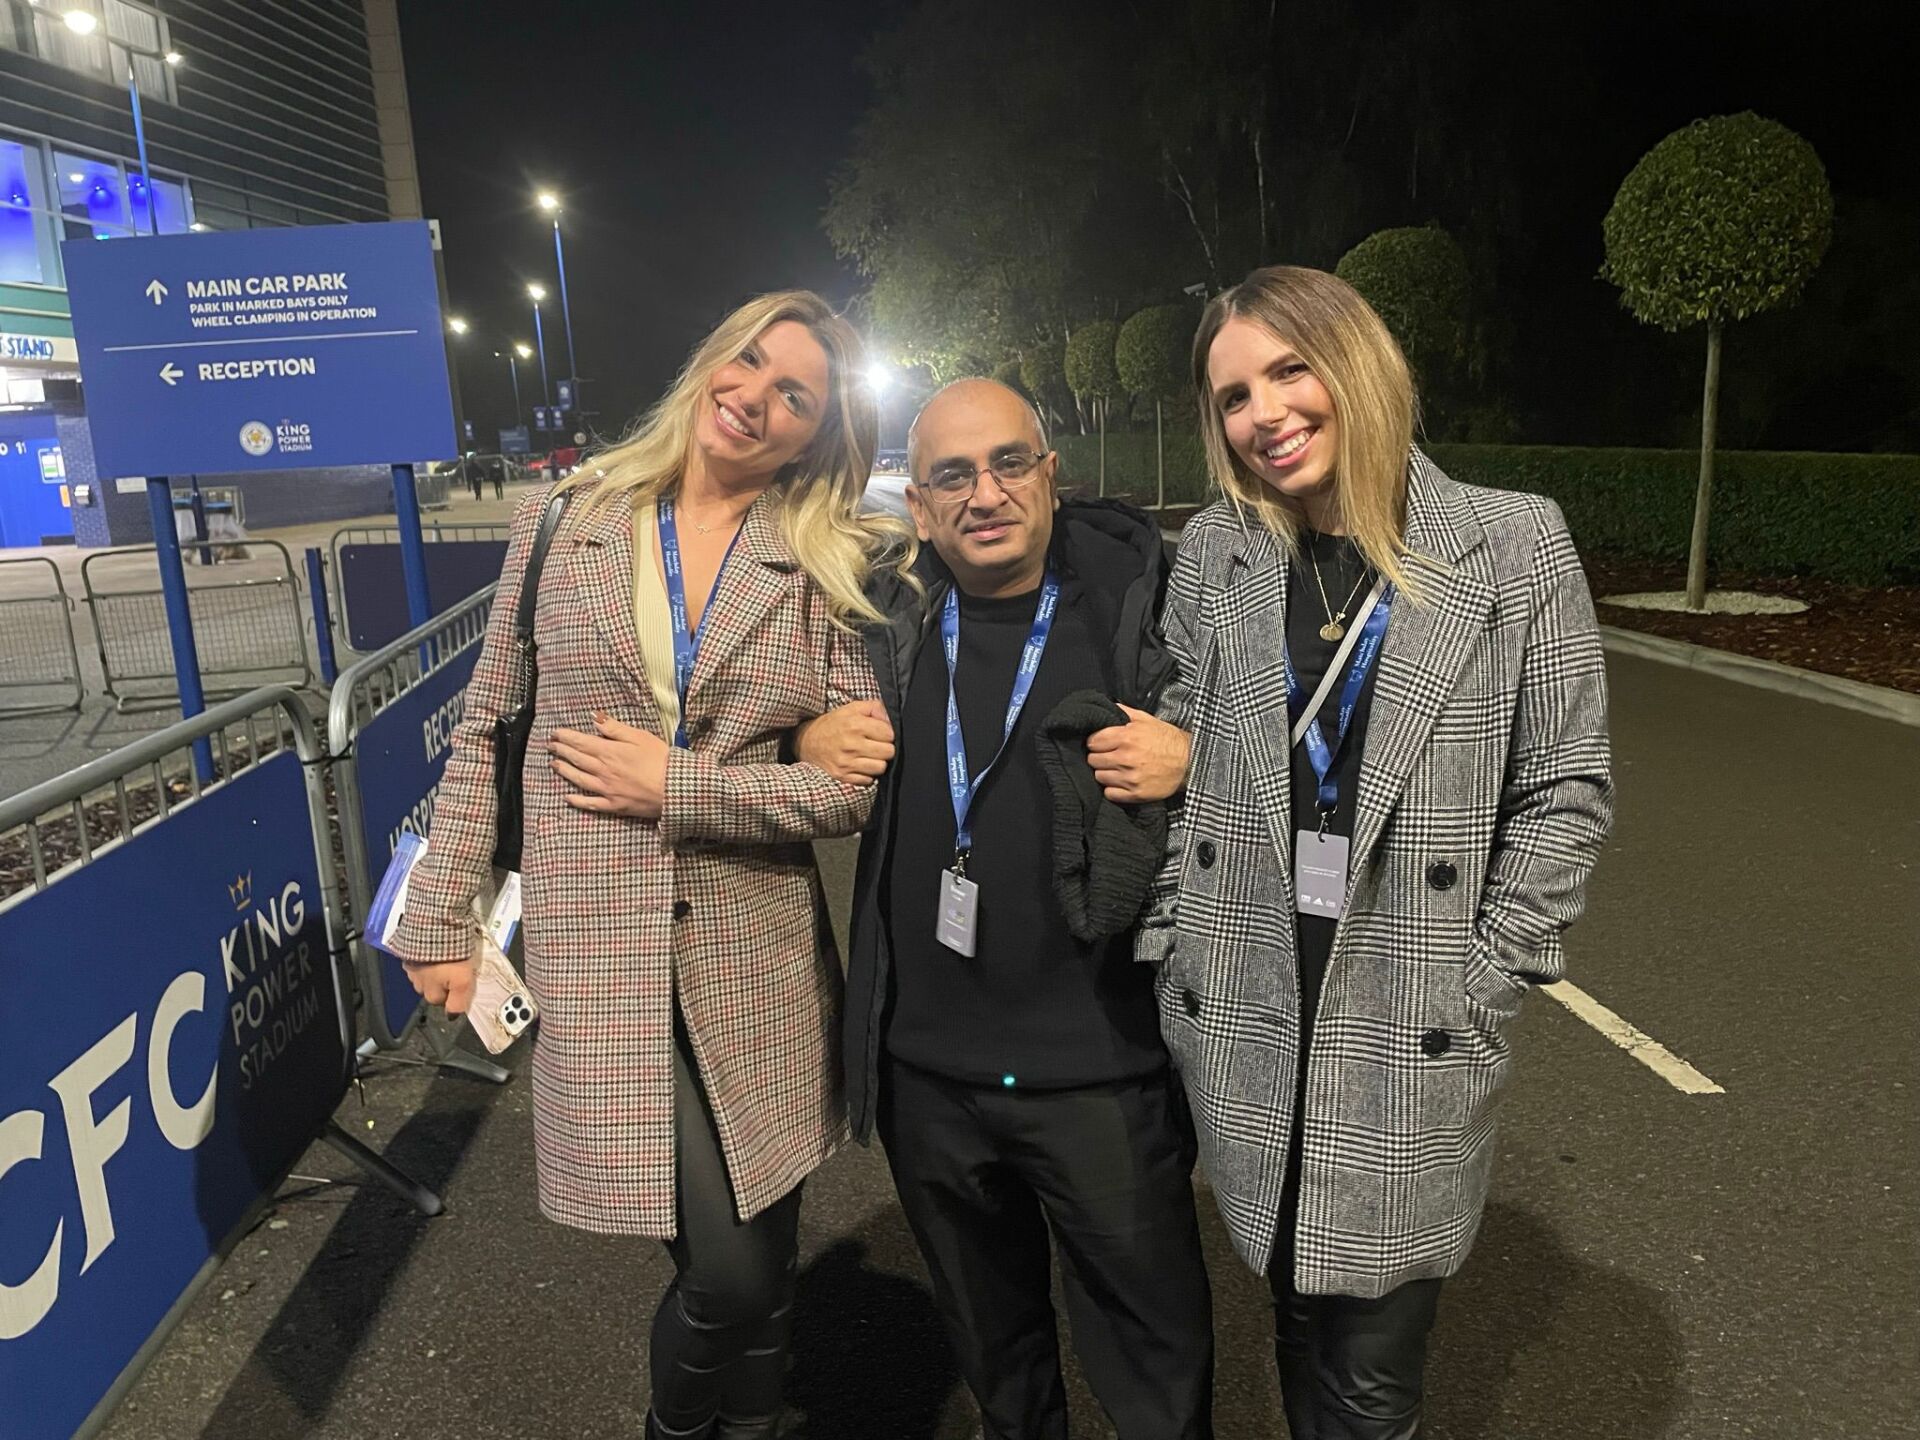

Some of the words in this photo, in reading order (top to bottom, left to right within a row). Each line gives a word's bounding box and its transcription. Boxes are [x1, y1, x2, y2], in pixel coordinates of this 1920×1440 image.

[187, 278, 242, 298] MAIN
[245, 276, 289, 295] CAR
[292, 273, 348, 292] PARK
[190, 301, 220, 314] PARK
[222, 302, 234, 312] IN
[236, 298, 285, 311] MARKED
[286, 297, 316, 308] BAYS
[317, 295, 349, 307] ONLY
[192, 315, 233, 328] WHEEL
[234, 311, 296, 325] CLAMPING
[297, 310, 309, 322] IN
[310, 307, 377, 322] OPERATION
[7, 336, 54, 360] STAND
[198, 357, 316, 380] RECEPTION
[276, 424, 310, 437] KING
[278, 434, 311, 445] POWER
[280, 443, 313, 453] STADIUM
[1353, 637, 1370, 667] Matchday
[1360, 635, 1379, 669] Hospitality
[423, 687, 466, 764] RECEPT
[389, 785, 438, 859] HSPI
[219, 880, 304, 994] KING
[231, 940, 313, 1047] POWER
[239, 985, 320, 1090] STADIUM
